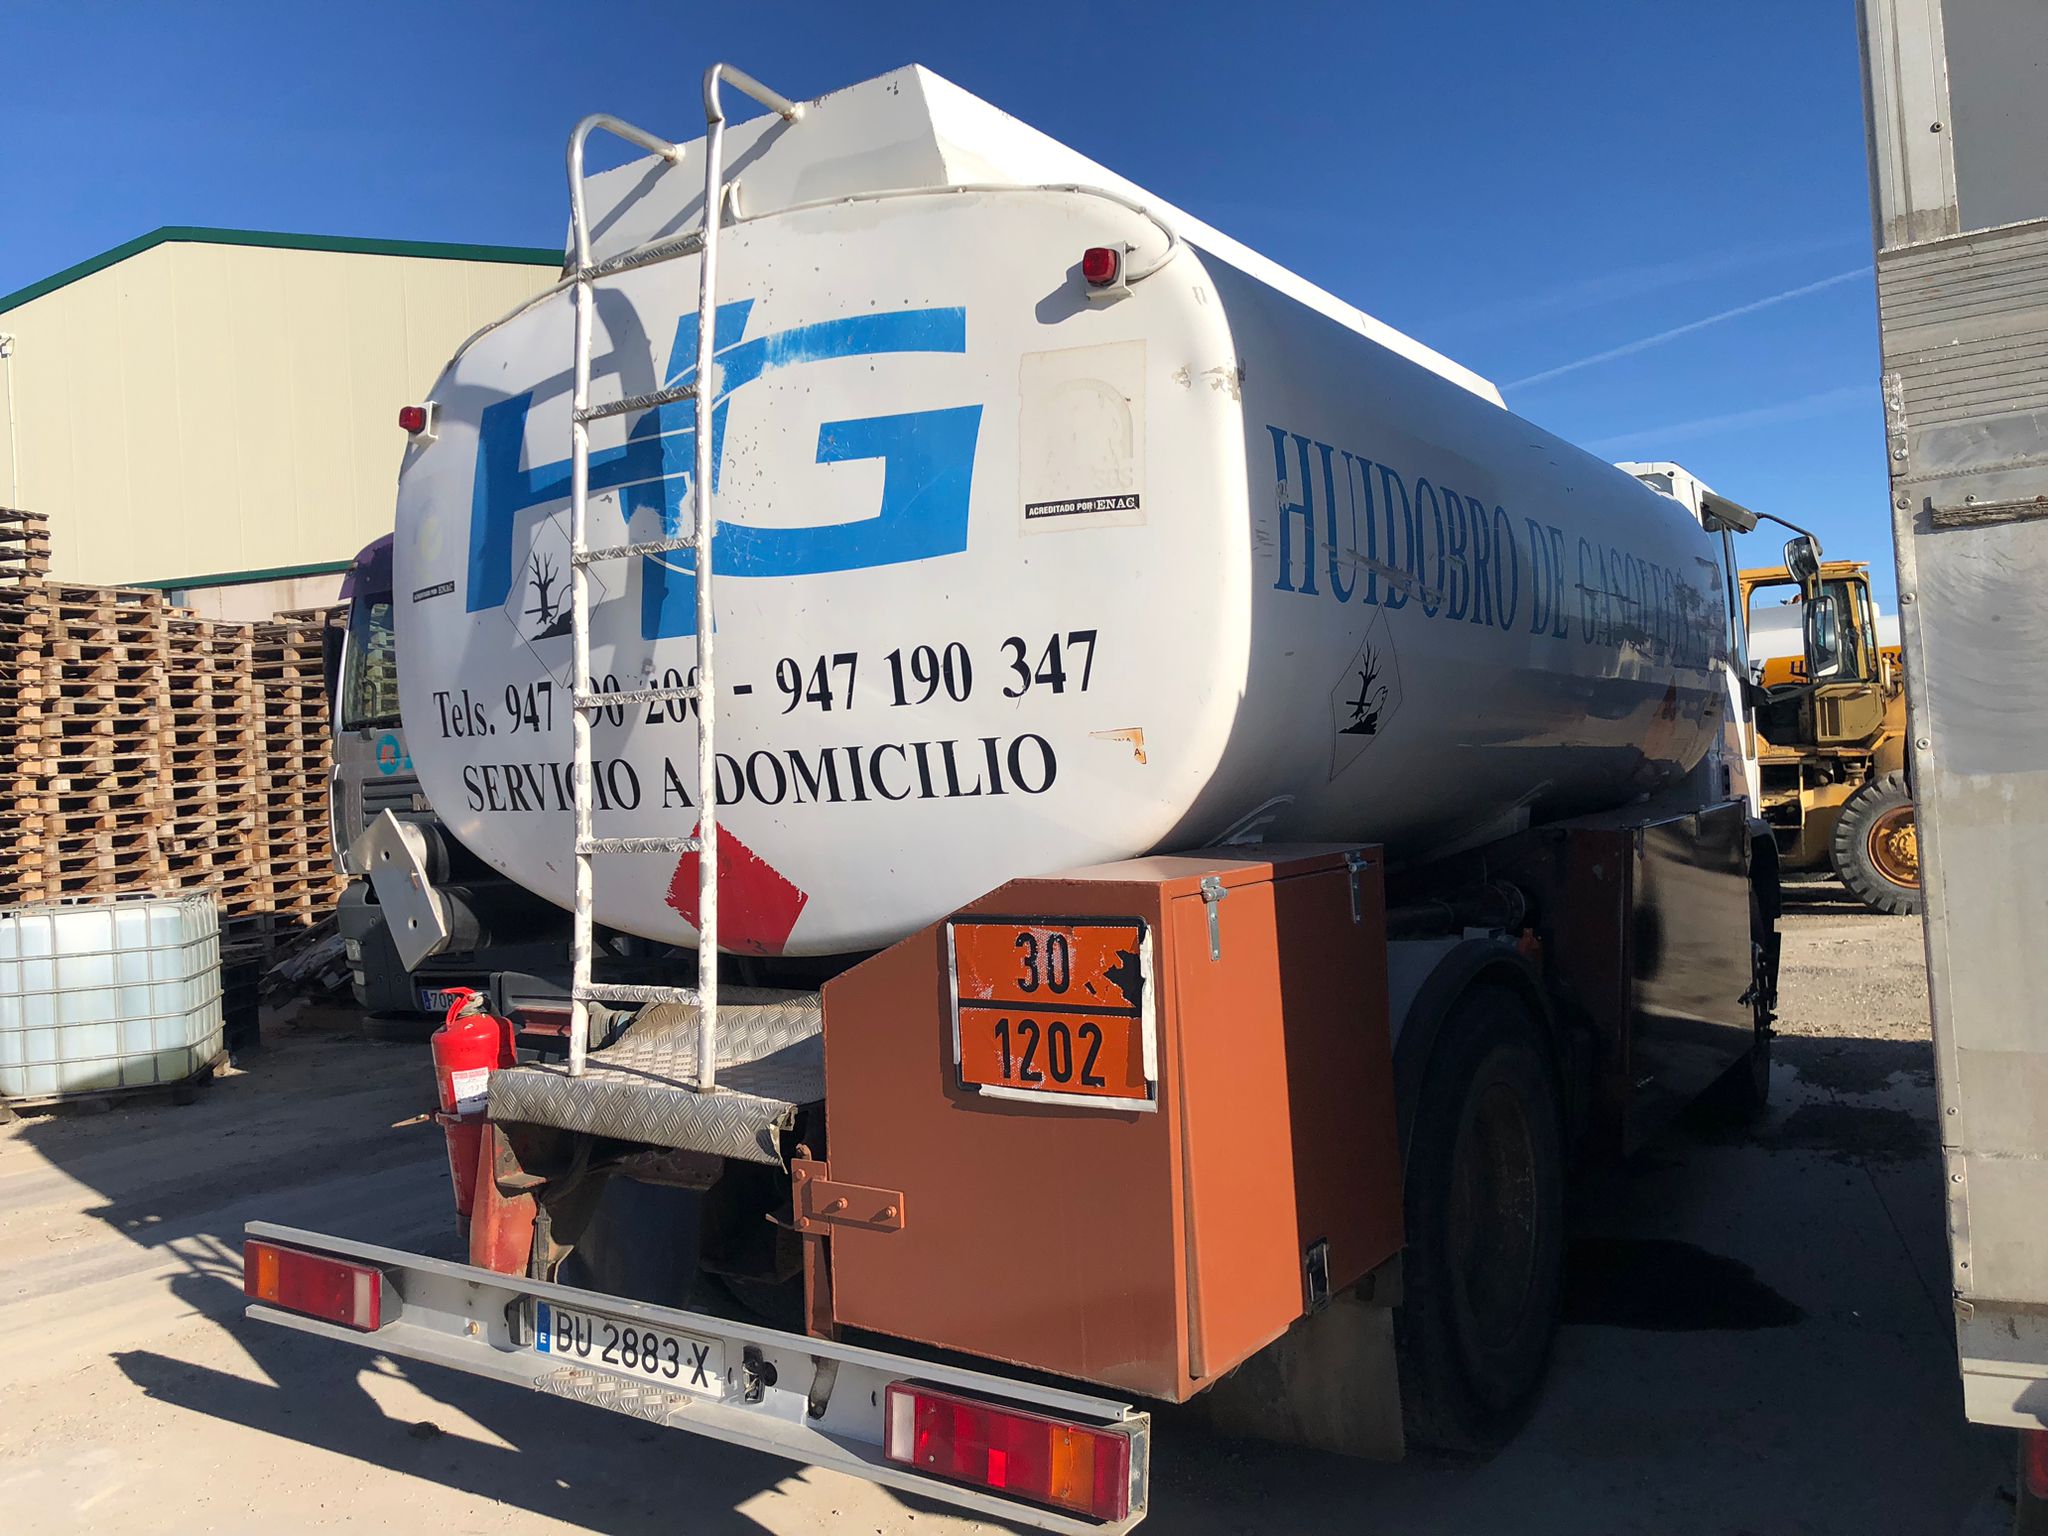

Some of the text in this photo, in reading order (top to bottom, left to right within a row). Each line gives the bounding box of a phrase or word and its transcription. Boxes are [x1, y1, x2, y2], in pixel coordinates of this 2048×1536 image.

[1028, 496, 1137, 516] ACREDITADO POR ENAC
[1266, 424, 1518, 631] HUIDOBRO
[1524, 516, 1570, 639] DE
[433, 690, 495, 738] Tels.
[505, 682, 554, 733] 947
[568, 674, 624, 728] 90
[776, 652, 859, 713] 947
[885, 641, 973, 706] 190
[1001, 629, 1099, 699] 347
[662, 757, 696, 809] A
[715, 733, 1058, 806] DOMICILIO
[1015, 932, 1071, 994] 30
[995, 1018, 1106, 1088] 1202
[540, 1332, 547, 1344] E
[556, 1311, 710, 1388] BU 2883 X
